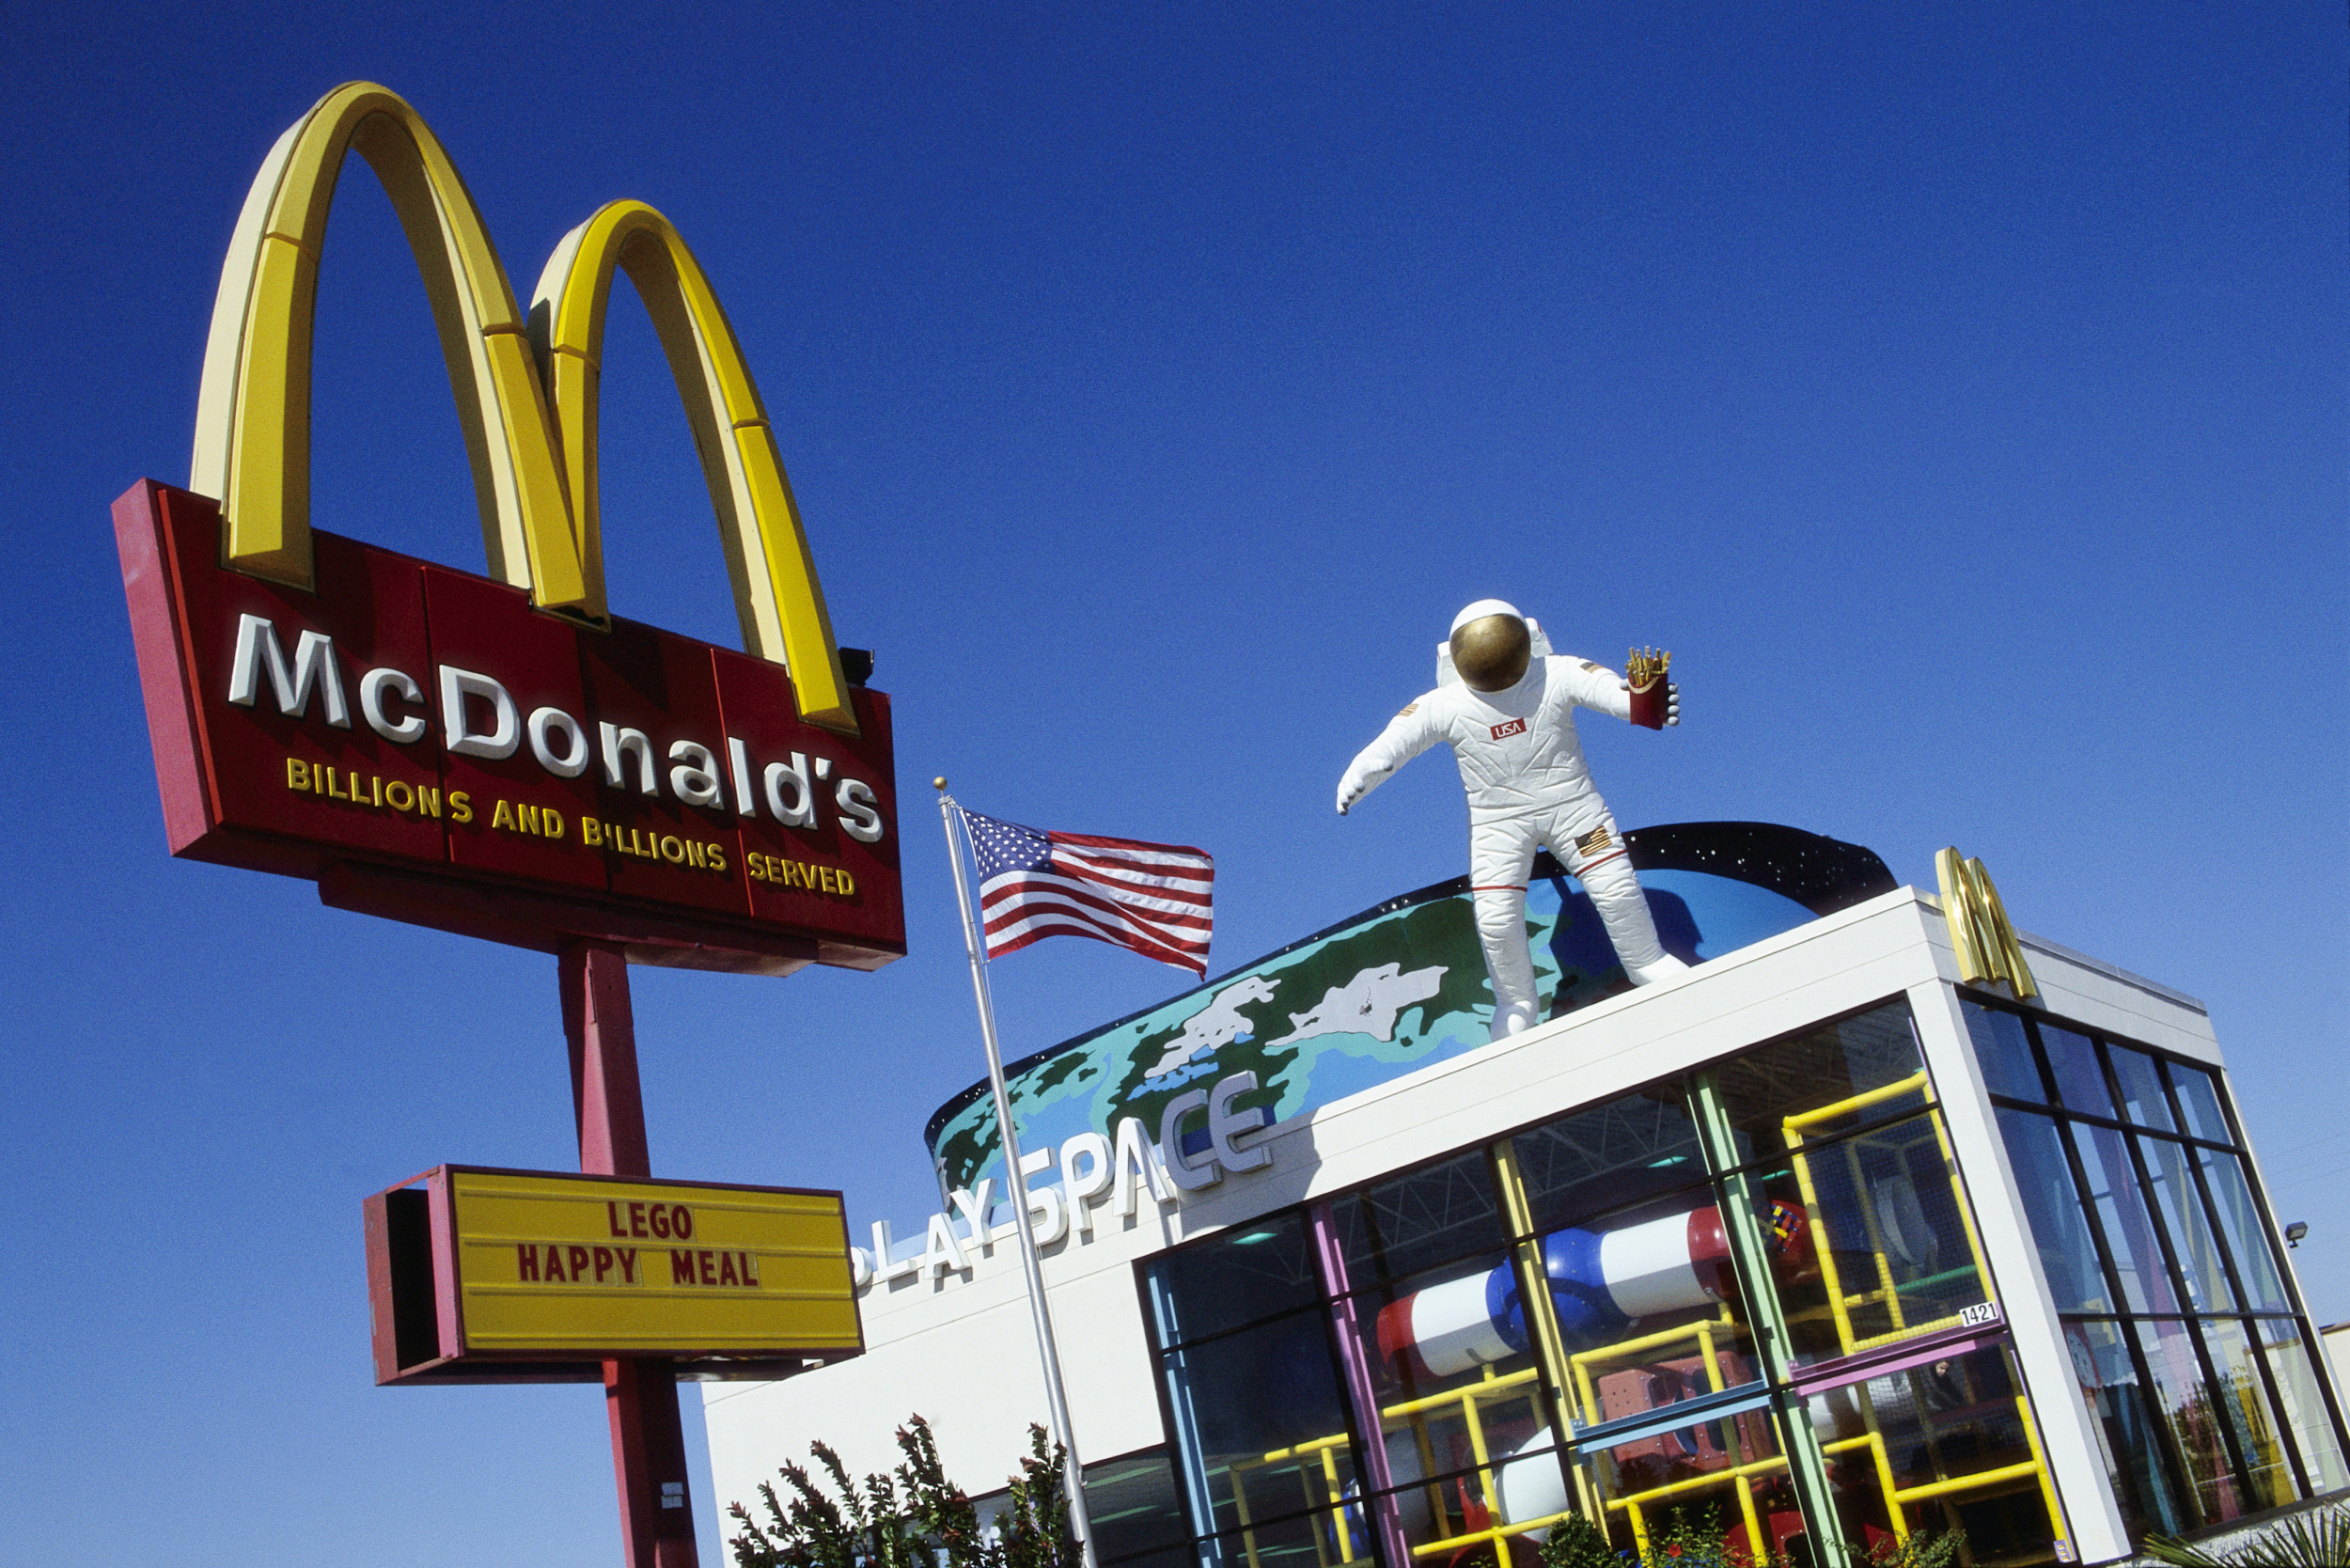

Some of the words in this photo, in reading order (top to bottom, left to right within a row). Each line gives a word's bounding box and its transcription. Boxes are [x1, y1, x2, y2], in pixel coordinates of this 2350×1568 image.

[228, 613, 884, 843] McDonald's
[1495, 721, 1522, 738] USA
[287, 757, 474, 824] BILLIONS
[492, 799, 565, 840] AND
[583, 816, 728, 872] BILLIONS
[747, 851, 856, 898] SERVED
[1007, 1069, 1274, 1248] SPACE
[607, 1200, 693, 1240] LEGO
[517, 1243, 637, 1284] HAPPY
[670, 1248, 759, 1287] MEAL
[1962, 1302, 1997, 1325] 1421
